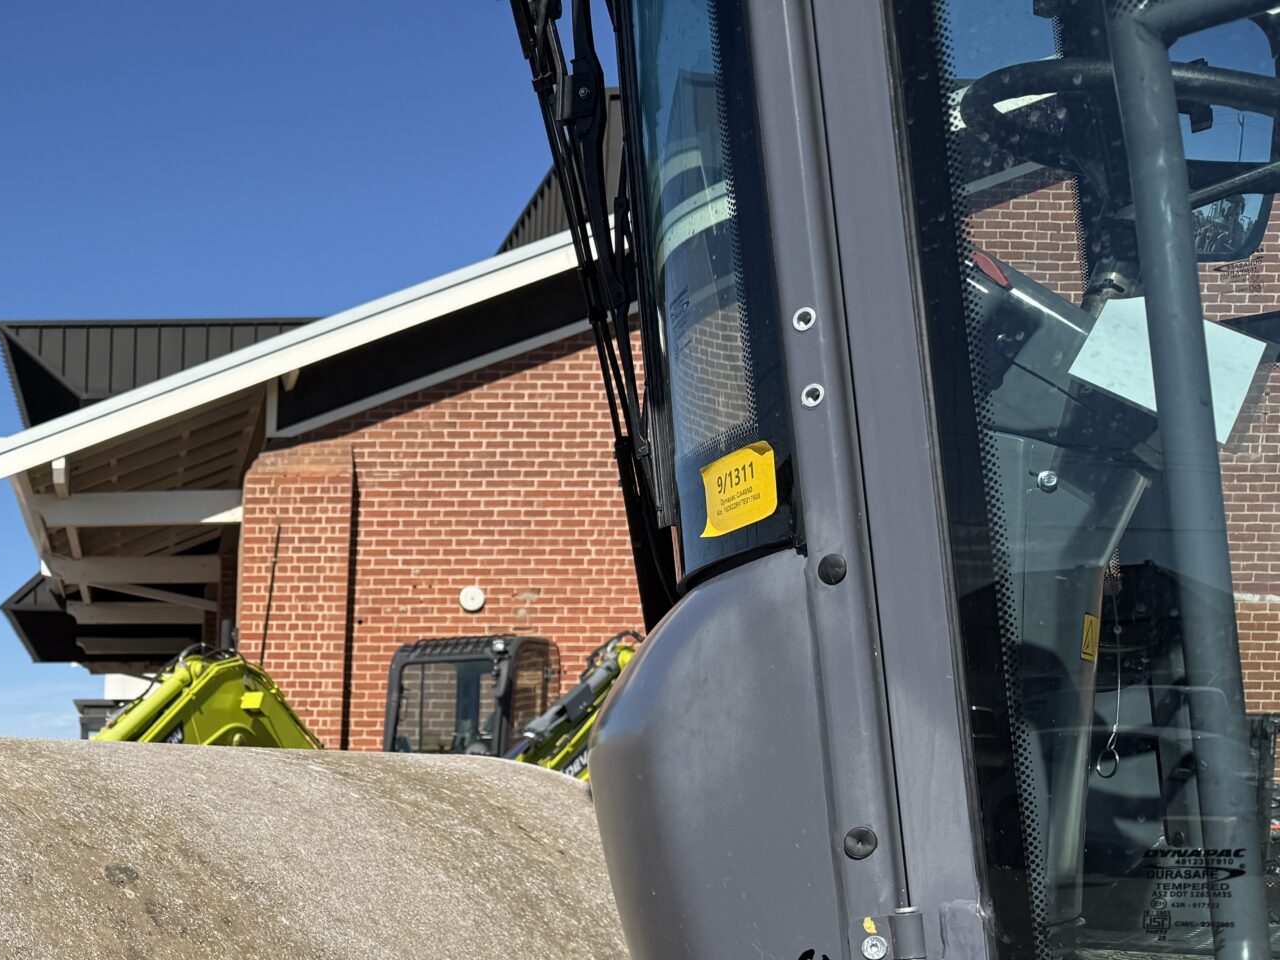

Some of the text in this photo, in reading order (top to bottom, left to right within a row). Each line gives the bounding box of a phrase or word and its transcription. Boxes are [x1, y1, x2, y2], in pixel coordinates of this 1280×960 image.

[717, 461, 754, 494] 9/1311
[1143, 848, 1247, 858] DYNAPAC
[1146, 869, 1218, 880] DURASAFE
[1155, 882, 1230, 891] TEMPERED
